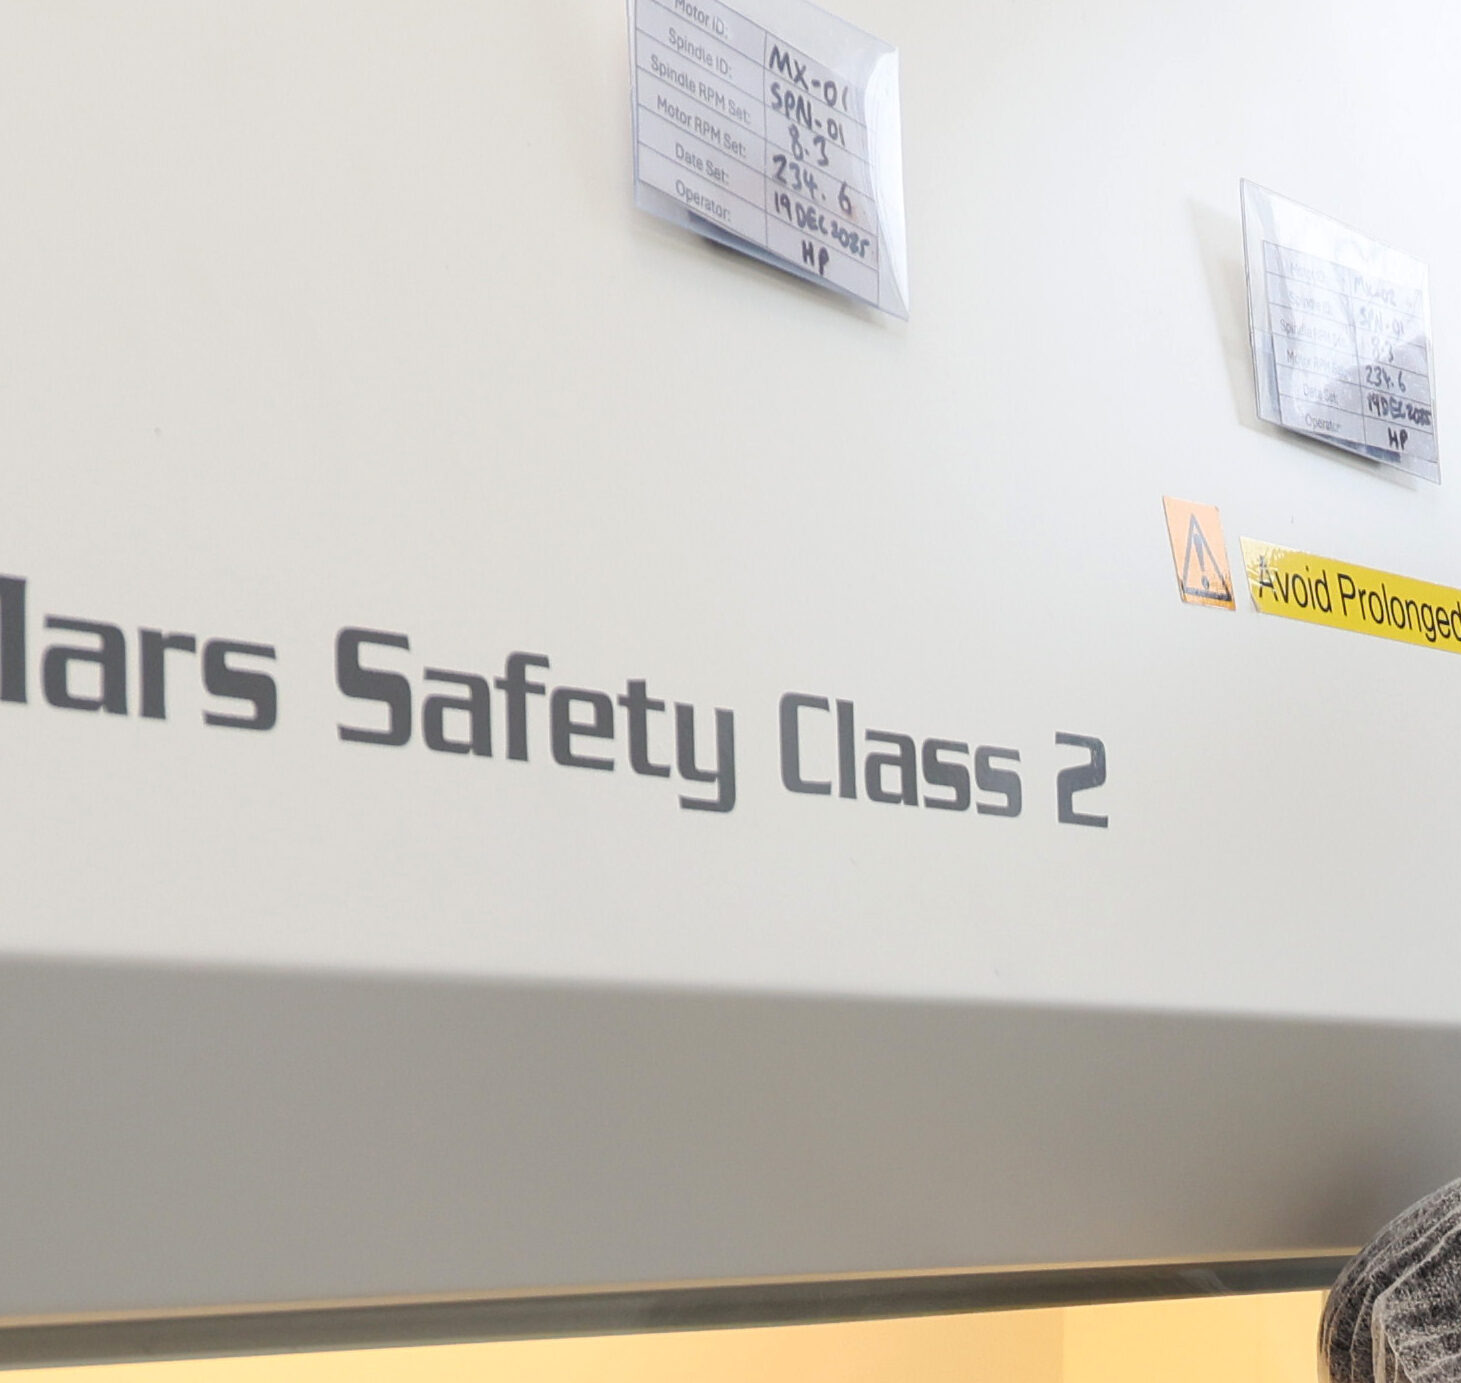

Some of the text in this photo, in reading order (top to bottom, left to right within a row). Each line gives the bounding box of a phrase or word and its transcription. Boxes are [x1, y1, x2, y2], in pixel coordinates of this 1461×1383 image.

[668, 27, 713, 67] Spindle
[650, 54, 697, 94] Spindle
[699, 81, 726, 111] RPM
[657, 94, 692, 127] Motor
[694, 116, 721, 145] RPM
[675, 142, 704, 171] Date
[787, 123, 829, 167] 8.3
[801, 240, 830, 276] HP
[1387, 427, 1408, 450] HP
[1257, 556, 1333, 615] Avoid
[335, 624, 738, 814] Safety
[779, 690, 1024, 818] Class
[1053, 730, 1110, 829] 2
